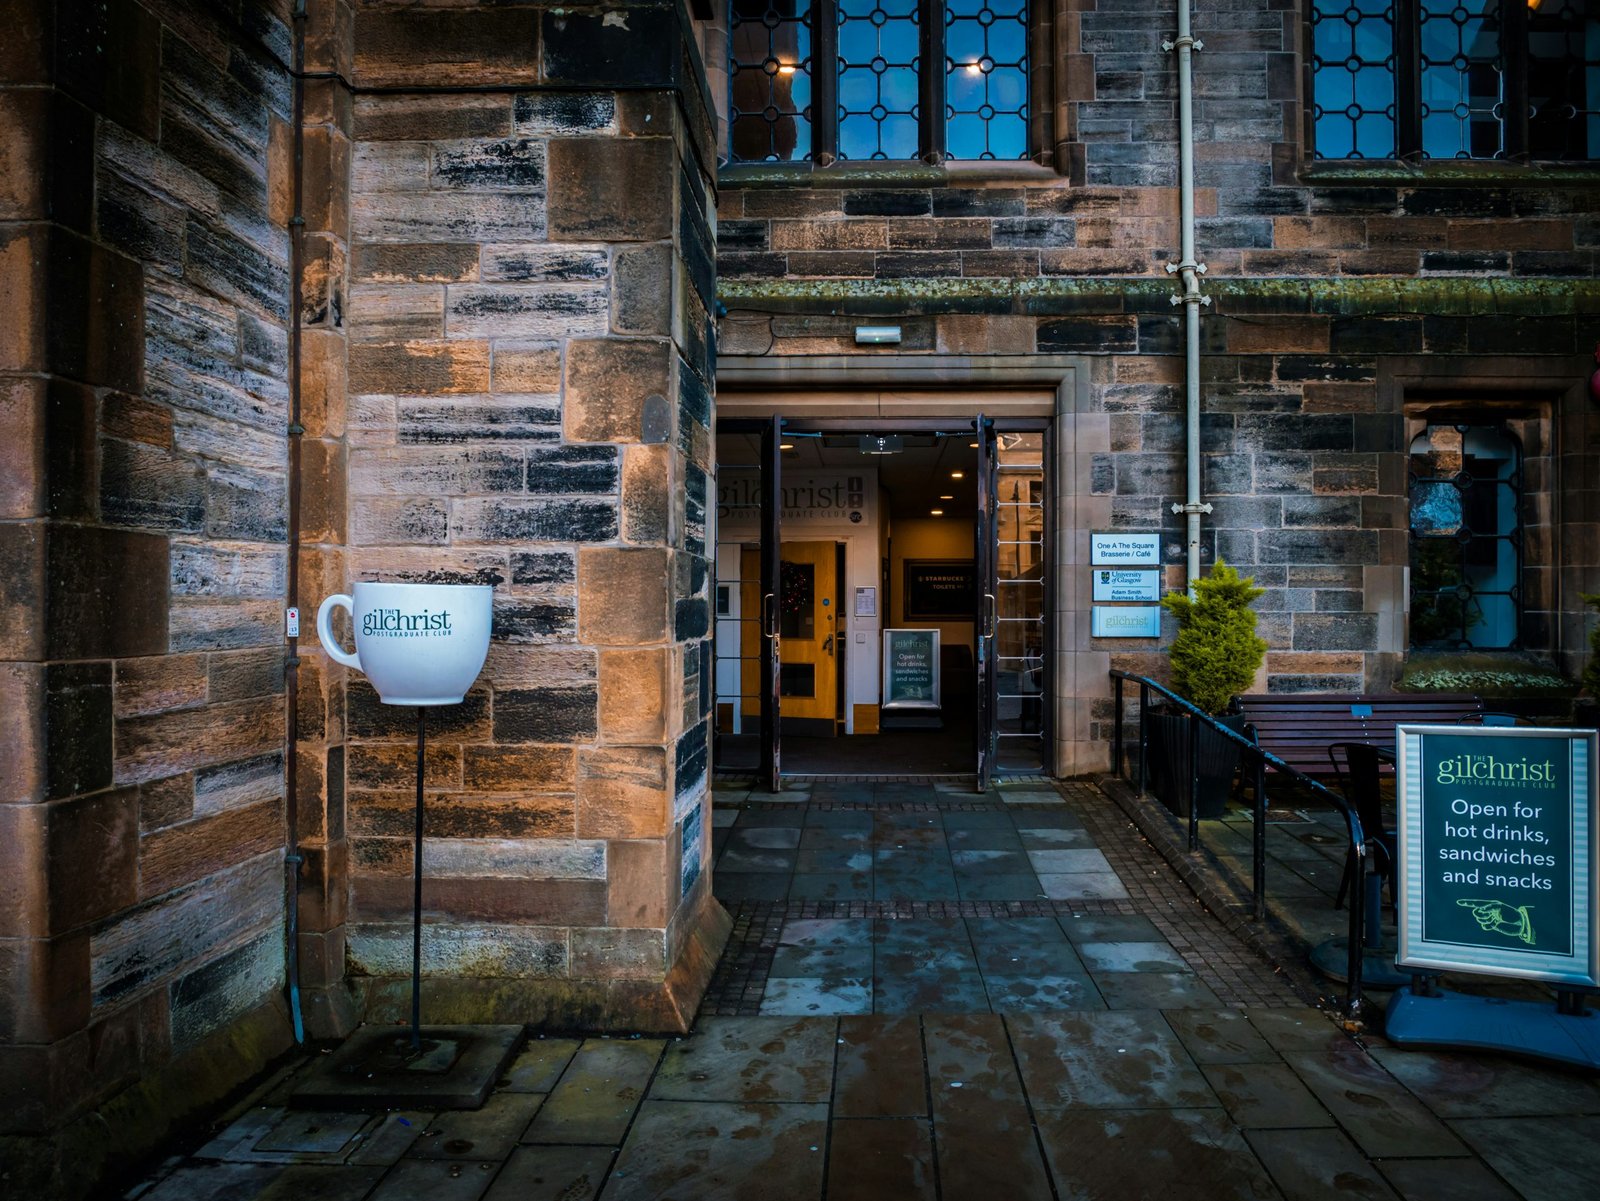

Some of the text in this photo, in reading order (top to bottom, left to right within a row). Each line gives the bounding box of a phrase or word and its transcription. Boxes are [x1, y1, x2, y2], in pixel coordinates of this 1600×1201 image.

[731, 510, 814, 519] POSTDUATE
[1131, 542, 1155, 550] Square
[1111, 571, 1142, 579] University
[1117, 577, 1142, 585] Glasgow
[362, 608, 452, 636] gilchrist
[1105, 615, 1149, 628] gilchrist
[1436, 754, 1556, 785] gilchrist
[1455, 778, 1556, 789] POSTGRADUATE CLUB
[1451, 798, 1543, 819] Open for
[1445, 821, 1550, 845] hot drinks,
[1439, 846, 1556, 867] sandwiches
[1442, 869, 1553, 890] and snacks
